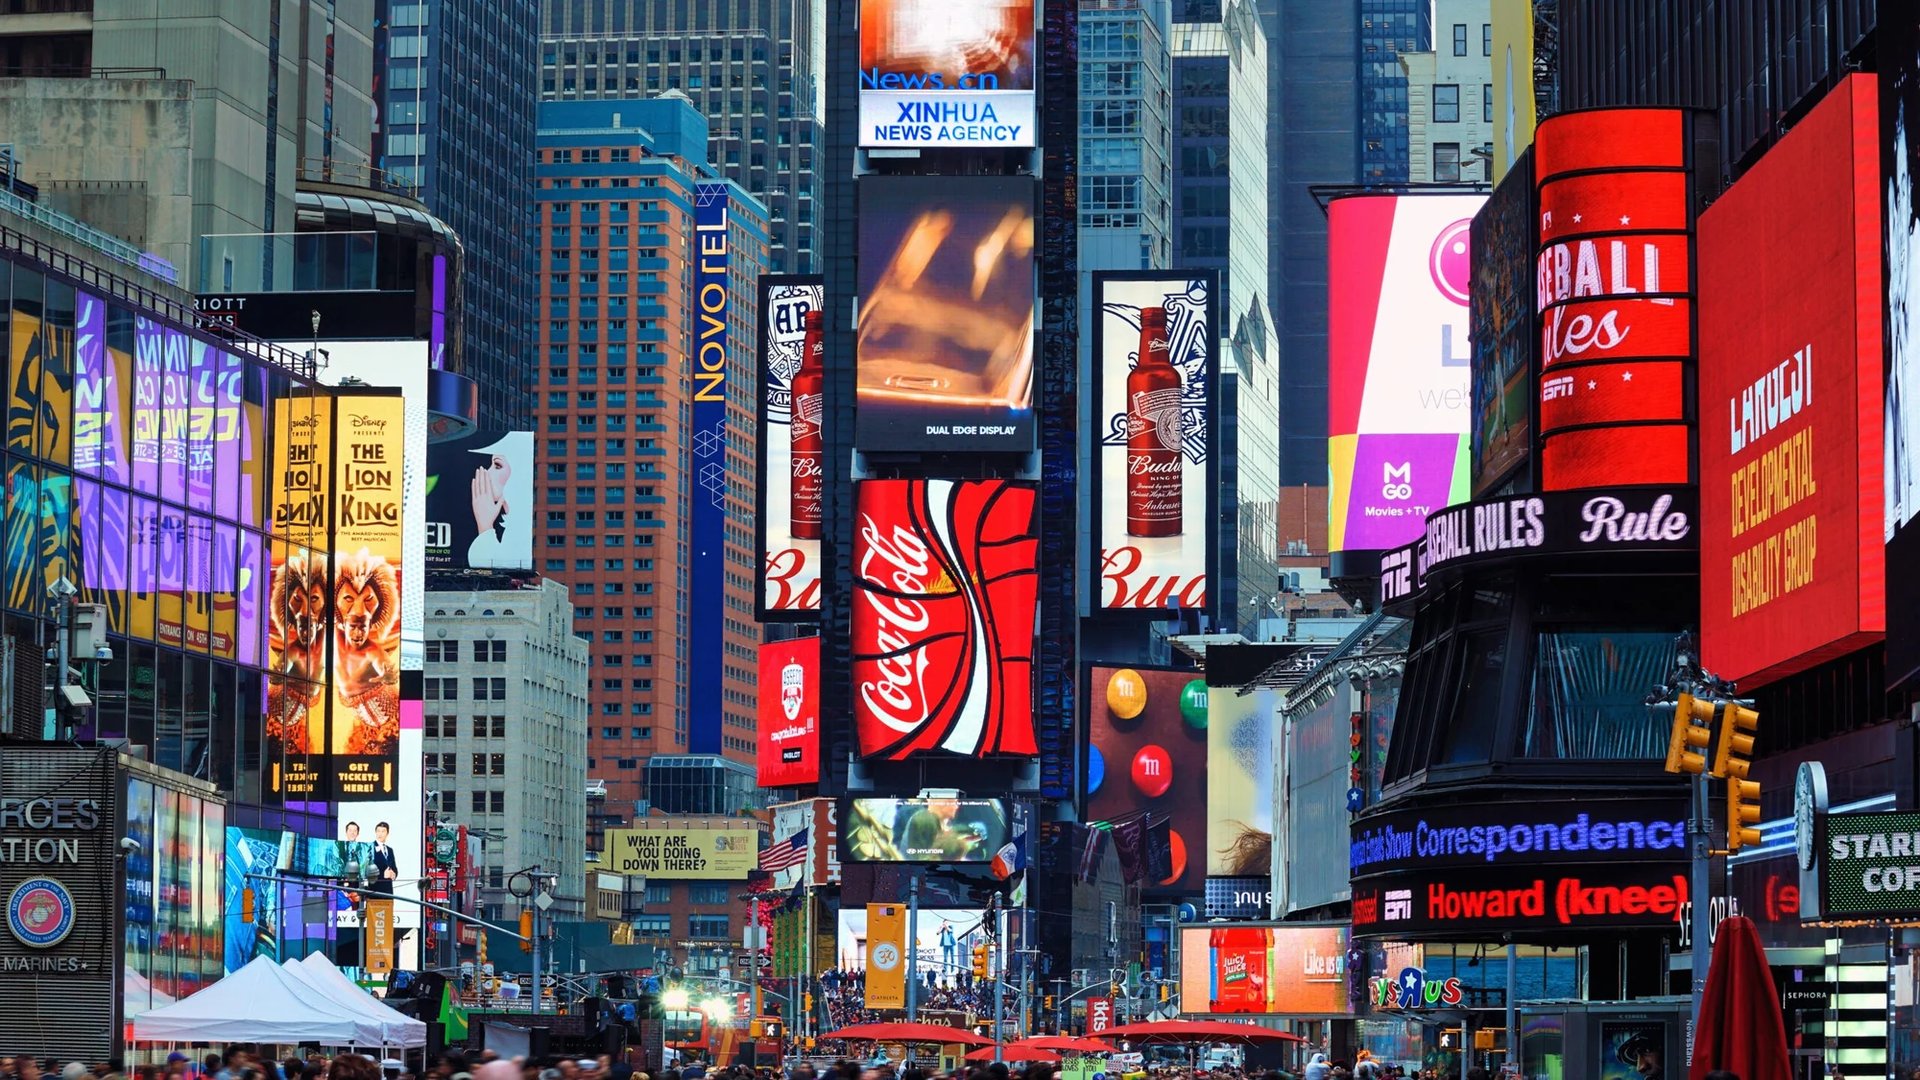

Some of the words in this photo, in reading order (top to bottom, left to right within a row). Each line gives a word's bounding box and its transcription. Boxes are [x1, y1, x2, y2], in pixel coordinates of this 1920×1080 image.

[860, 67, 999, 90] News.cn
[897, 102, 999, 123] XINHUA
[875, 125, 932, 141] NEWS
[938, 125, 1021, 141] AGENCY
[694, 207, 727, 401] NOVOTEL
[348, 414, 387, 431] Disney
[926, 426, 950, 434] DUAL
[953, 426, 977, 434] EDGE
[979, 426, 1016, 434] DISPLAY
[351, 444, 384, 459] THE
[345, 464, 392, 492] LION
[1731, 425, 1816, 538] DEVELOPMENTAL
[341, 494, 397, 527] KING
[1365, 506, 1403, 517] Movies
[1413, 506, 1430, 516] TV
[1579, 494, 1690, 543] Rule
[1474, 498, 1545, 553] RULES
[1732, 532, 1781, 618] DISABILITY
[1784, 514, 1816, 593] GROUP
[187, 629, 194, 642] ON
[338, 773, 379, 782] TICKETS
[349, 763, 370, 771] GET
[344, 784, 374, 792] HERE!
[0, 799, 99, 830] RCES
[0, 838, 79, 864] TION
[627, 836, 660, 847] WHAT
[664, 836, 687, 847] ARE
[636, 848, 659, 859] YOU
[664, 848, 701, 859] DOING
[623, 860, 660, 872] DOWN
[665, 860, 706, 871] THERE?
[1428, 880, 1545, 919] Howard
[1555, 875, 1688, 925] (knee)
[374, 909, 386, 946] YOGA
[3, 956, 79, 972] MARINES
[1787, 991, 1827, 999] SEPHORA
[1093, 1001, 1110, 1032] tkts
[1685, 1019, 1693, 1067] Newsstand
